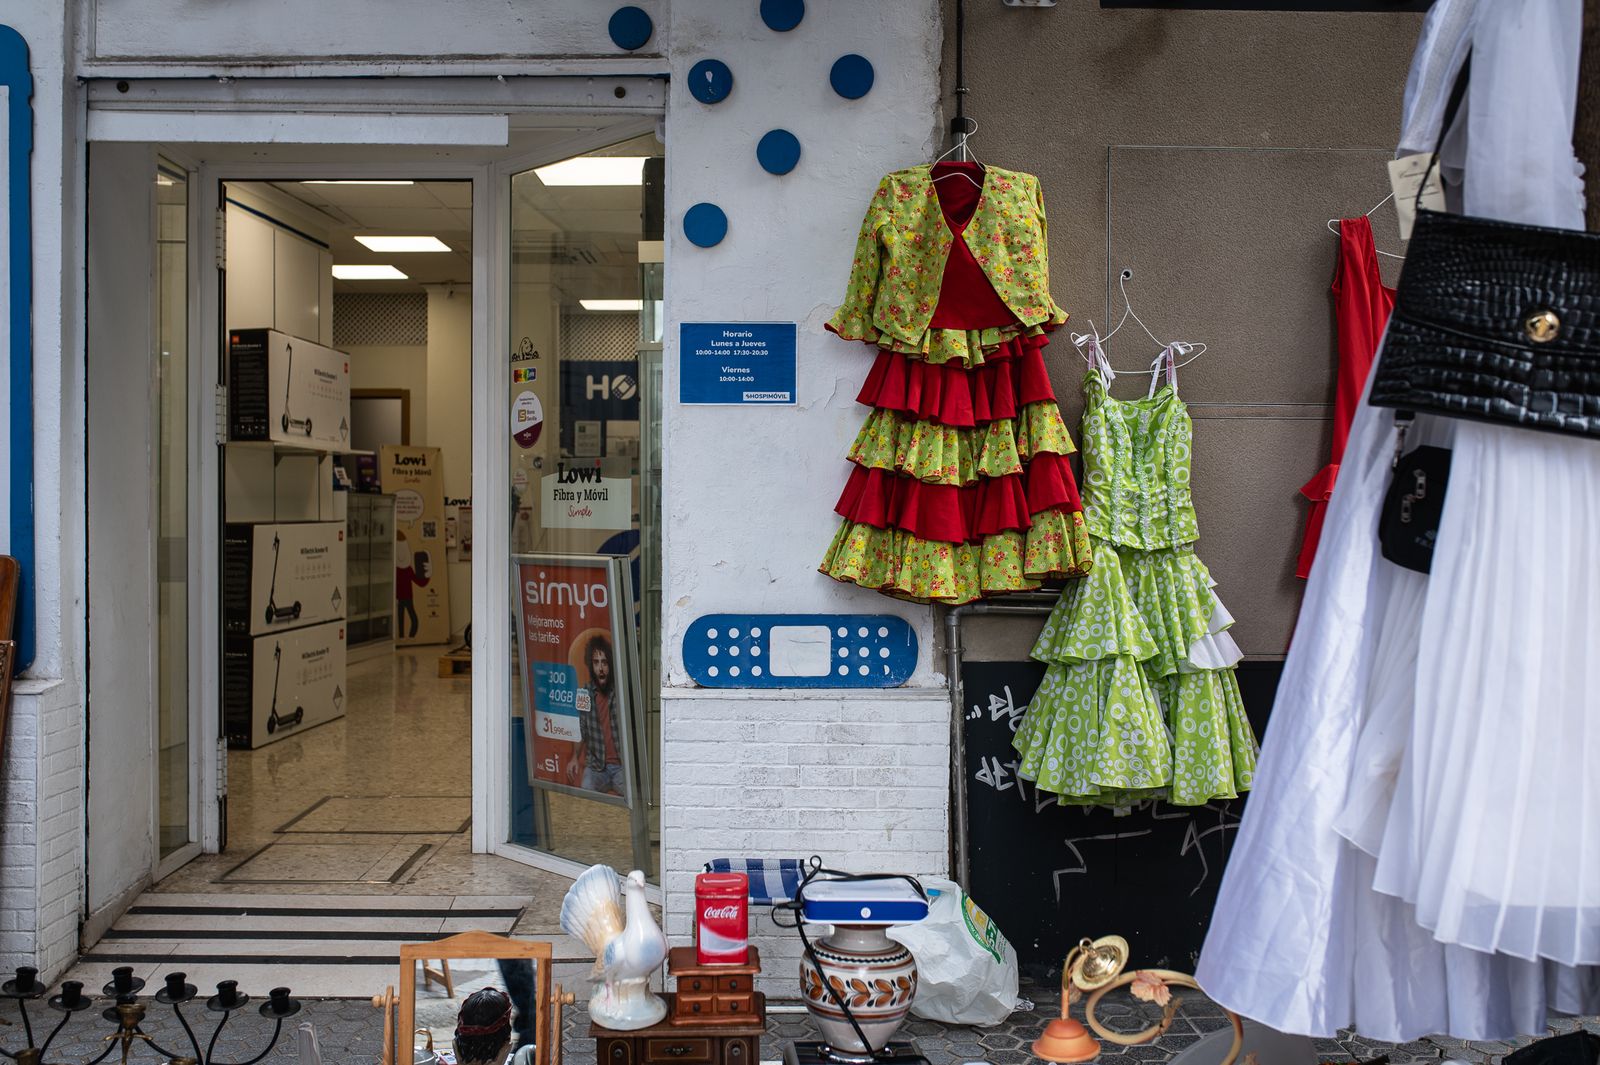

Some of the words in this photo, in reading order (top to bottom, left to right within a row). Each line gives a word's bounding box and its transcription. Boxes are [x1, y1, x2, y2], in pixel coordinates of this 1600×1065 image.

[394, 454, 426, 466] Lowi
[557, 459, 602, 484] Lowi
[553, 489, 574, 501] Fibra
[576, 492, 582, 503] y
[584, 489, 608, 501] Móvil
[568, 506, 592, 518] Simple
[526, 572, 608, 619] simyo
[528, 614, 564, 629] Mejoramos
[529, 631, 538, 641] las
[538, 632, 560, 644] tarifas
[548, 672, 566, 684] 300
[549, 690, 573, 702] 40GB
